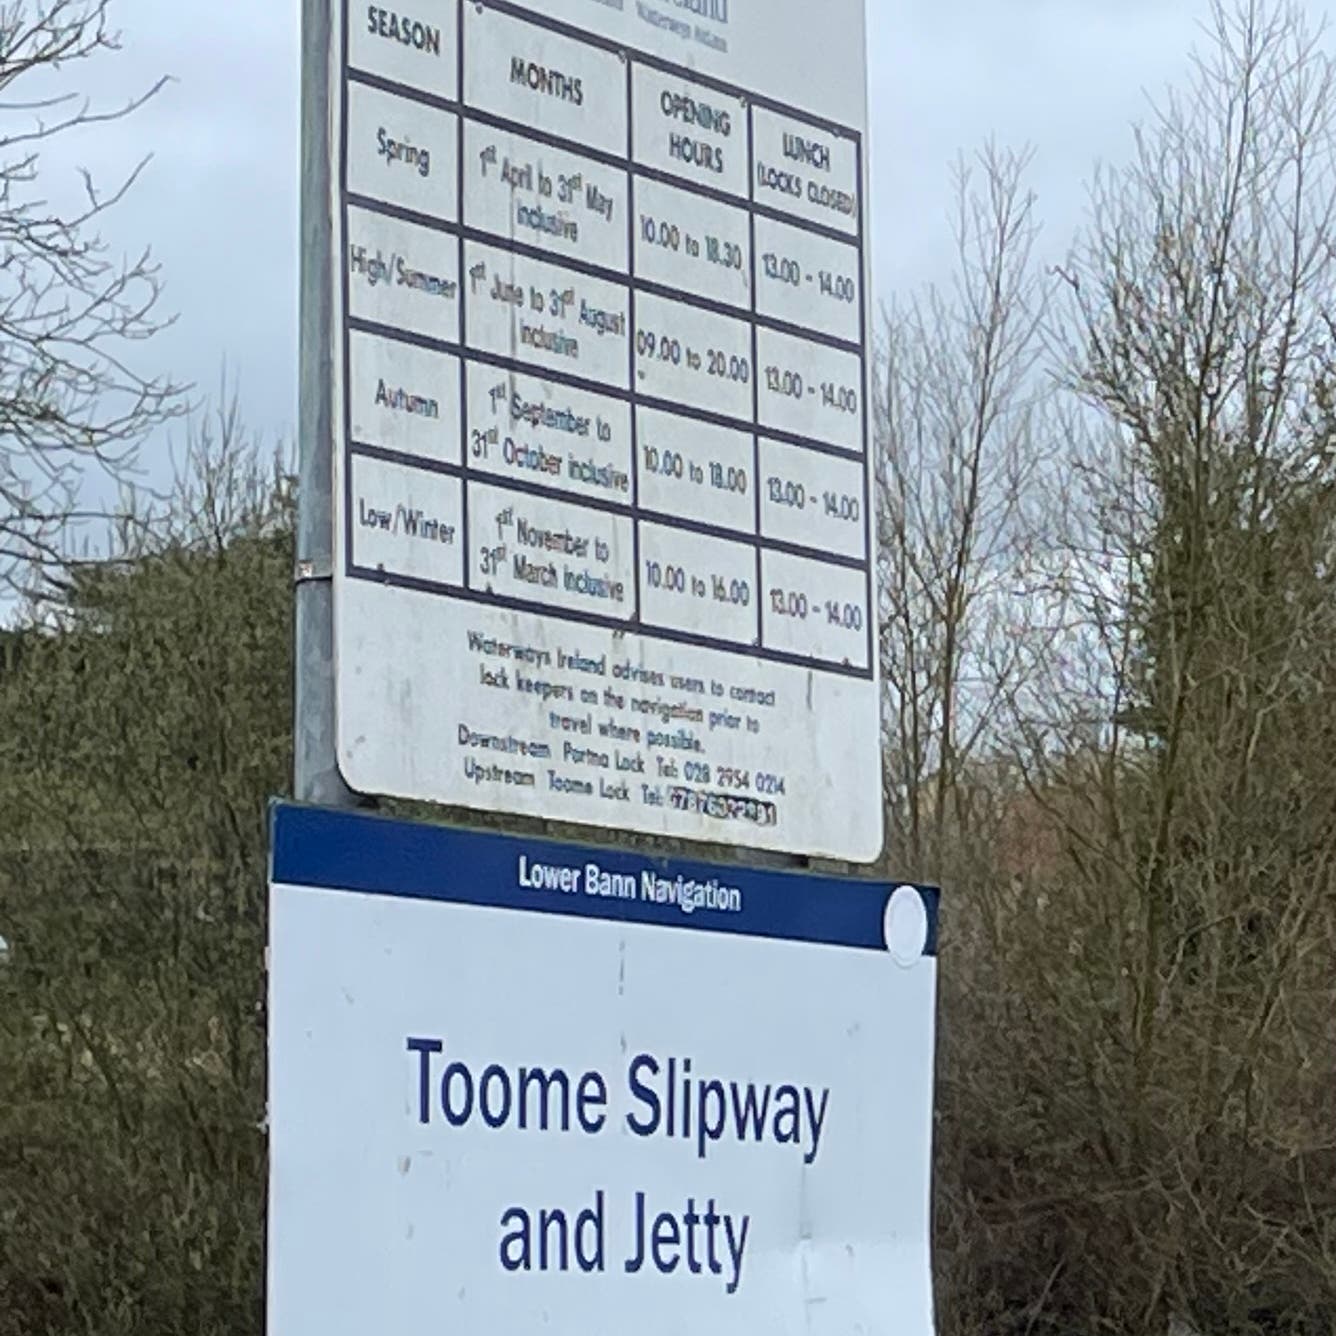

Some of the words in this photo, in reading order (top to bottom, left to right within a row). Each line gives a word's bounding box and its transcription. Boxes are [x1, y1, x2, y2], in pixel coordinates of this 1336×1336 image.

[368, 5, 440, 57] SEASON
[509, 56, 583, 106] MONTHS
[660, 90, 731, 137] OPENING
[377, 127, 430, 177] Spring
[669, 132, 723, 173] HOURS
[782, 132, 831, 172] LUNCH
[500, 156, 533, 192] April
[537, 158, 552, 197] to
[586, 182, 613, 223] May
[757, 161, 802, 198] (LOCKS
[807, 180, 857, 218] CLOSED)
[516, 199, 578, 242] inclusive
[640, 214, 680, 252] 10.00
[685, 233, 699, 257] to
[705, 235, 742, 270] 18.30
[761, 252, 800, 287] 13.00
[818, 269, 855, 303] 14.00
[490, 273, 524, 308] June
[529, 286, 543, 314] to
[578, 298, 626, 336] August
[636, 328, 681, 365] 09.00
[686, 347, 701, 370] to
[706, 348, 749, 383] 20.00
[374, 378, 439, 419] Autumn
[764, 365, 802, 399] 13.00
[820, 381, 857, 414] 14.00
[510, 392, 590, 436] September
[596, 415, 611, 442] to
[503, 437, 562, 476] October
[567, 452, 628, 492] inclusive
[643, 445, 682, 479] 10.00
[689, 460, 703, 484] to
[708, 462, 747, 495] 18.00
[767, 476, 805, 510] 13.00
[823, 490, 859, 522] 14.00
[517, 516, 589, 557] November
[595, 536, 609, 562] to
[513, 553, 558, 589] March
[563, 564, 624, 602] inclusive
[646, 559, 685, 593] 10.00
[691, 575, 706, 598] to
[711, 574, 750, 606] 16.00
[769, 587, 807, 619] 13.00
[824, 600, 862, 631] 14.00
[467, 630, 551, 669] Waterways
[557, 647, 606, 676] Ireland
[612, 658, 665, 687] advises
[670, 675, 705, 695] users
[710, 679, 724, 697] to
[730, 686, 775, 706] contact
[479, 662, 510, 690] lock
[515, 669, 573, 701] keepers
[580, 688, 598, 705] on
[603, 685, 624, 709] the
[631, 695, 704, 724] navigation
[709, 708, 741, 732] prior
[746, 715, 760, 734] to
[549, 711, 592, 735] travel
[598, 716, 640, 743] where
[458, 723, 551, 759] Downstream
[563, 740, 609, 768] Portna
[615, 749, 645, 773] Lock
[684, 761, 710, 783] 028
[464, 755, 535, 786] Upstream
[547, 769, 593, 795] Toome
[600, 776, 630, 801] Lock
[518, 855, 581, 893] Lower
[584, 863, 636, 900] Bann
[641, 870, 741, 913] Navigation
[406, 1038, 607, 1134] Toome
[625, 1053, 830, 1165] Slipway
[498, 1190, 604, 1273] and
[624, 1191, 750, 1295] Jetty
